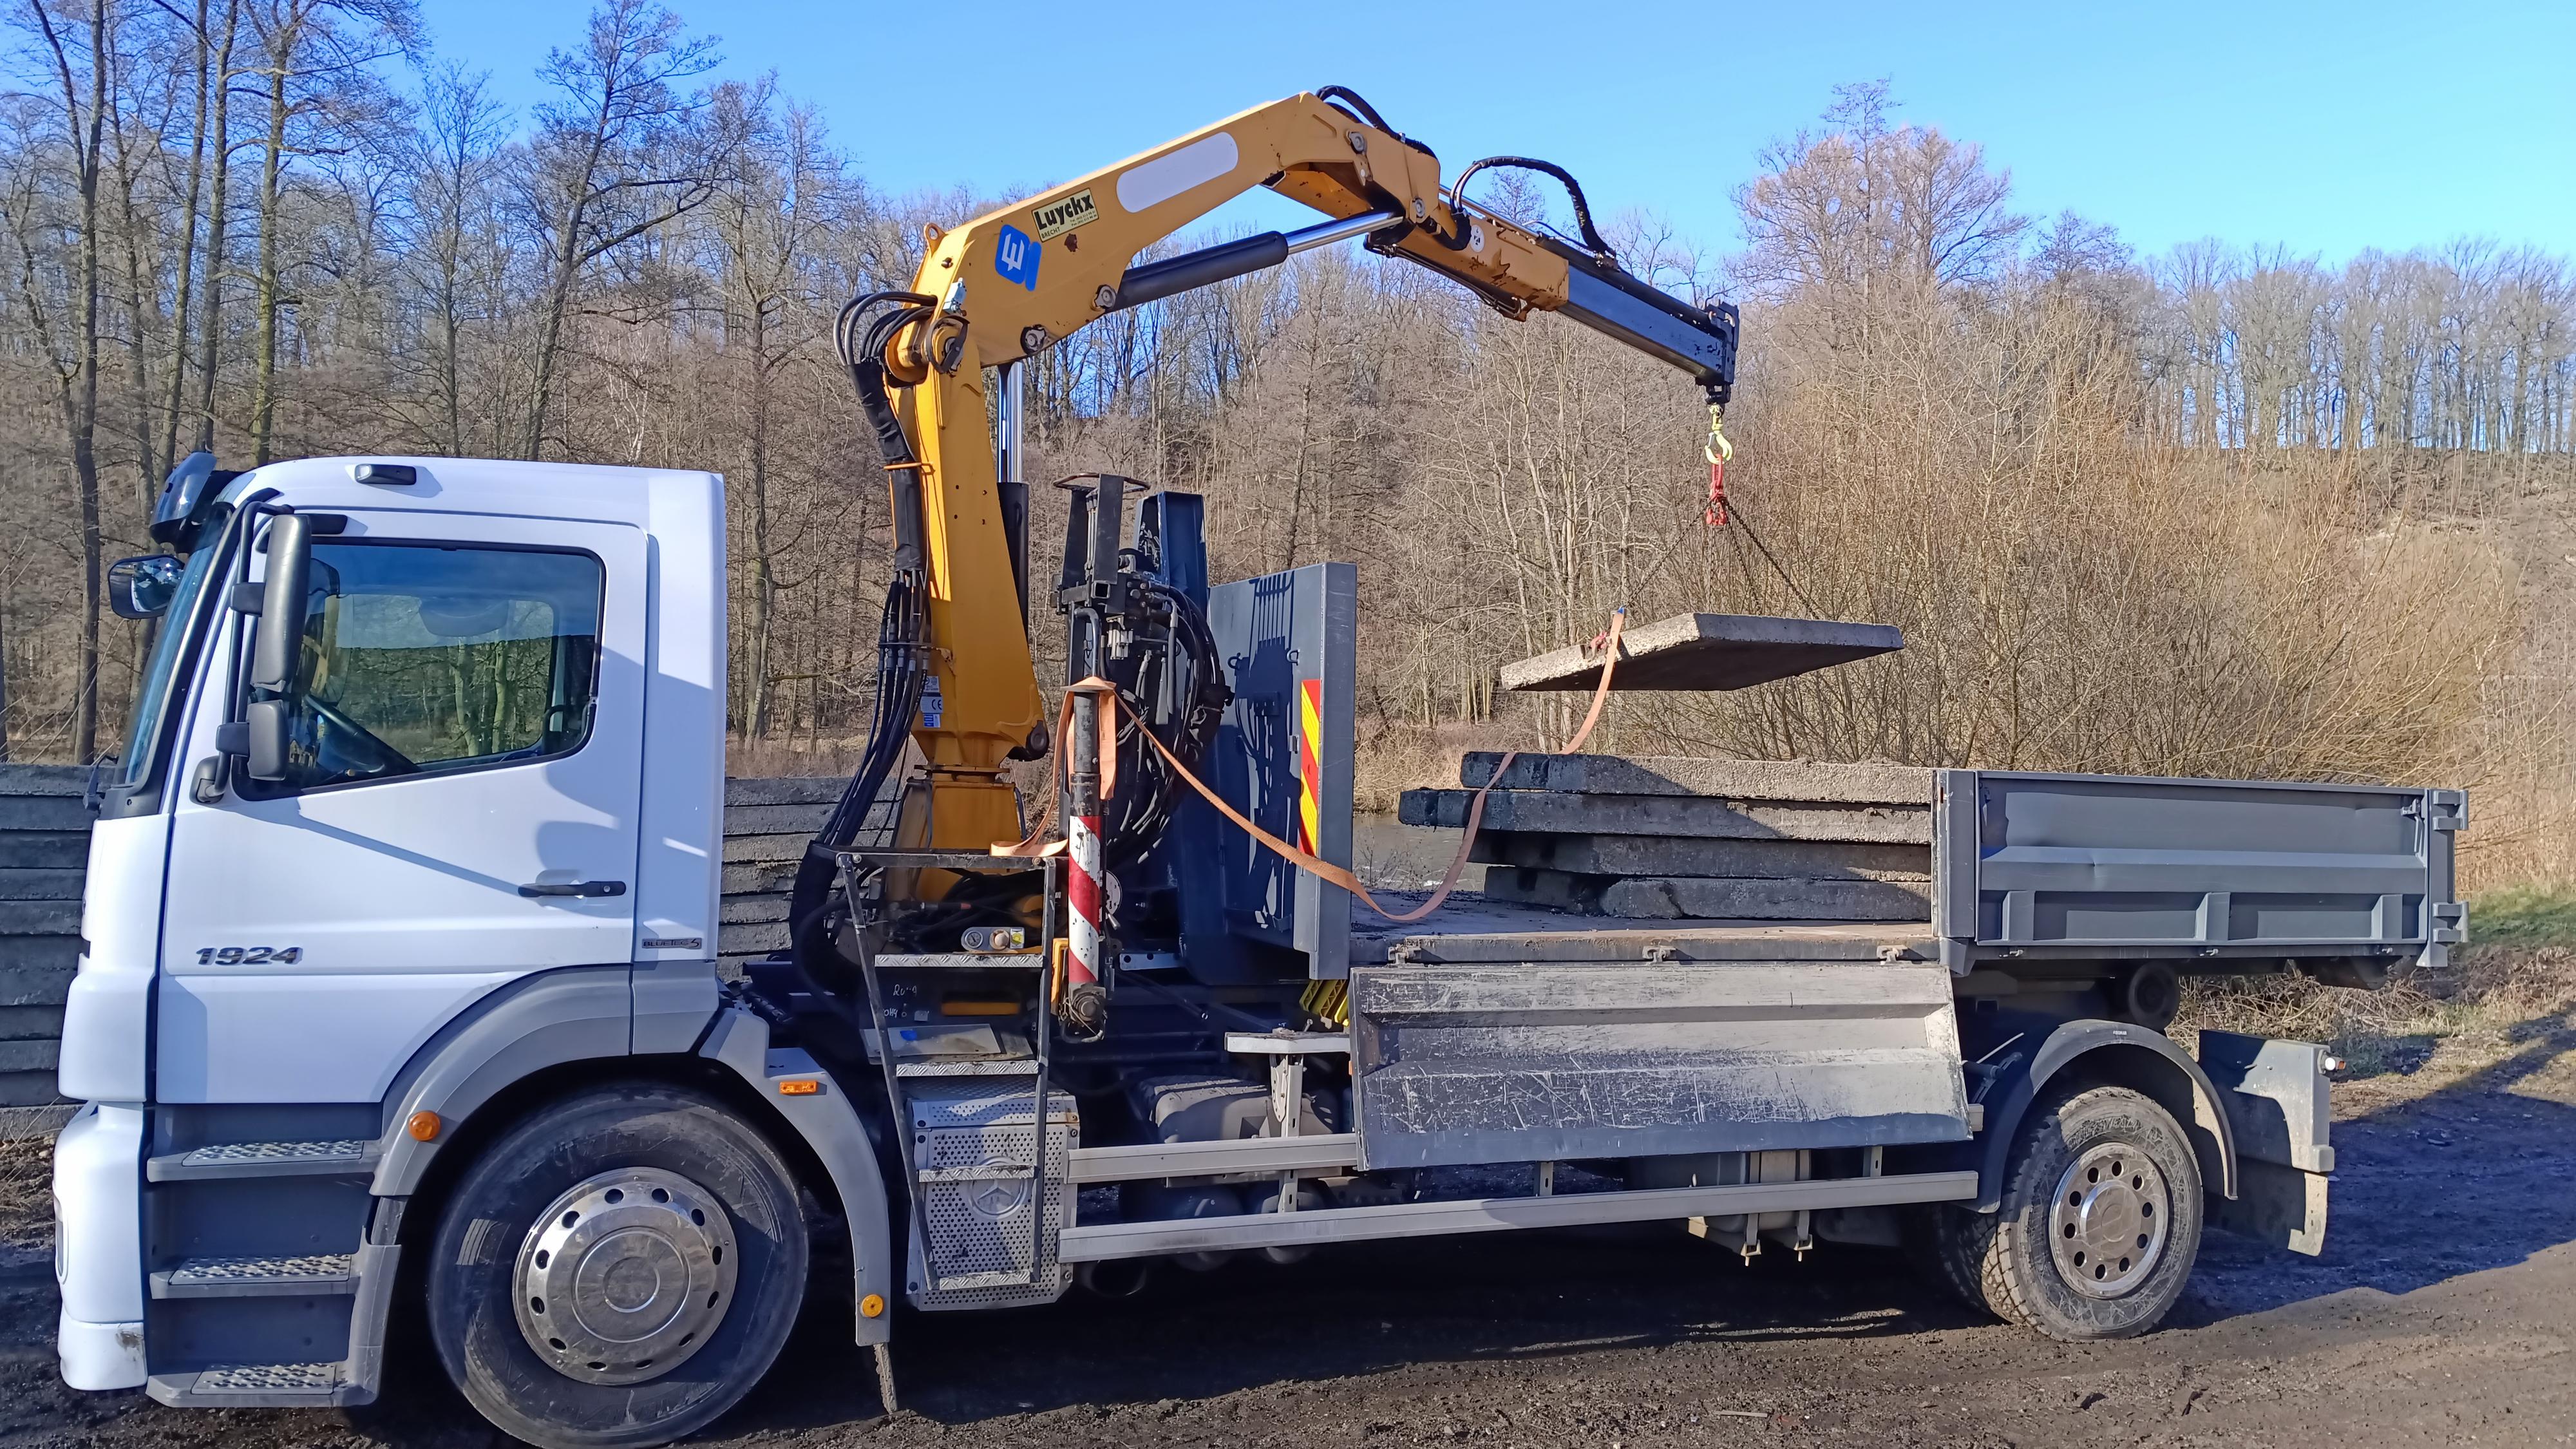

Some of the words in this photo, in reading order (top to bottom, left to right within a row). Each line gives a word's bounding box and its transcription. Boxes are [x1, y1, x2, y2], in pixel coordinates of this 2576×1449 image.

[1034, 194, 1094, 230] Luyckx
[1041, 227, 1061, 238] BRECHT
[196, 947, 301, 966] 1924
